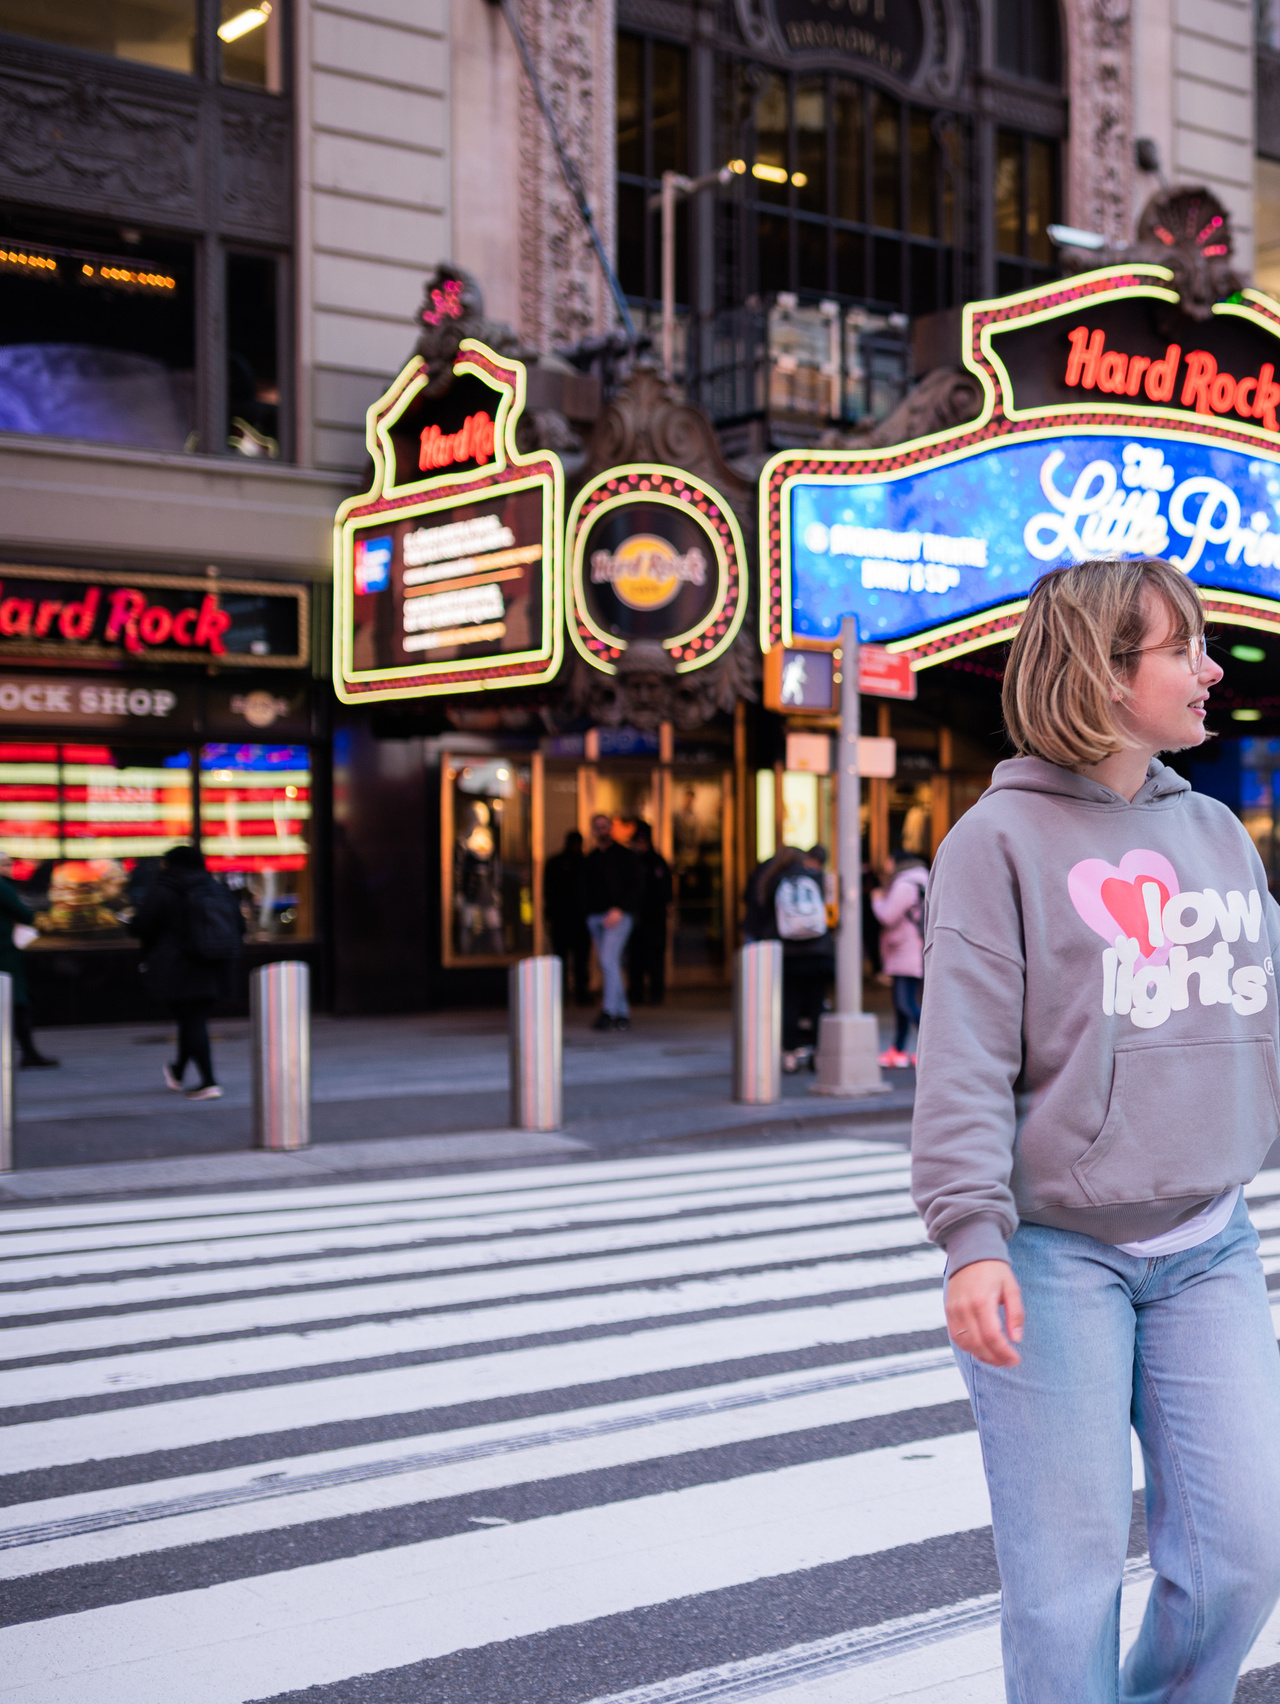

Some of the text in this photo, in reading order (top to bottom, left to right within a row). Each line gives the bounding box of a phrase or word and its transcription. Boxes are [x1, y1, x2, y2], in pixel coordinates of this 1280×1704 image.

[1065, 326, 1181, 402] Hard
[0, 580, 232, 657] ard Rock
[0, 683, 177, 717] OCK SHOP
[1142, 882, 1262, 948] low
[1102, 941, 1268, 1029] lights
